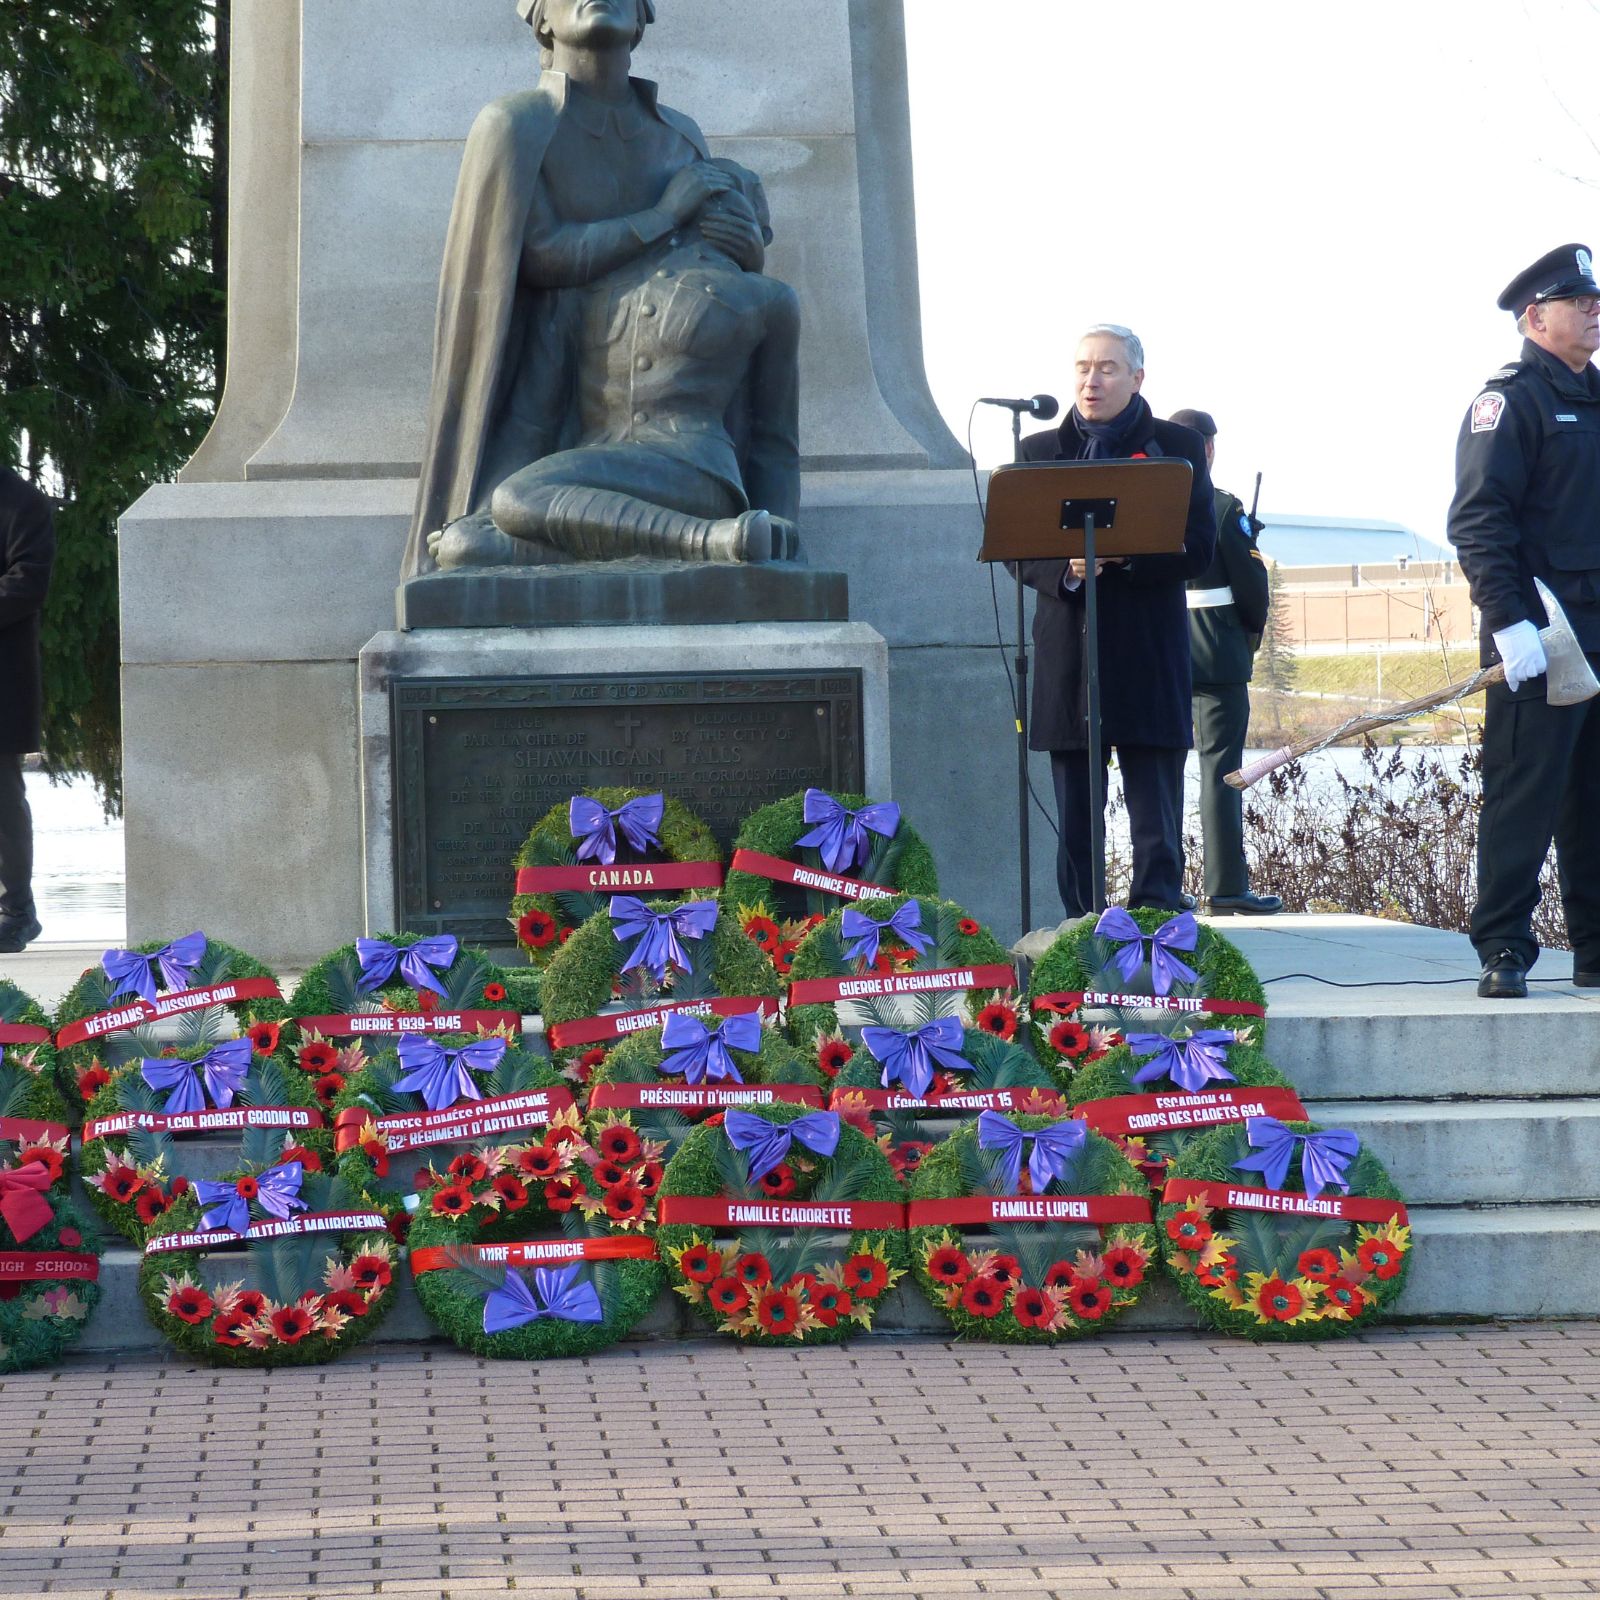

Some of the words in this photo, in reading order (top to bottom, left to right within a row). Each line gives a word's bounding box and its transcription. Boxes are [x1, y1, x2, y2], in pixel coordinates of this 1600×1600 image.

[463, 734, 496, 747] PAR
[500, 734, 520, 746] LA
[566, 732, 586, 746] DE
[671, 728, 689, 743] BY
[697, 728, 727, 742] THE
[733, 728, 768, 742] CITY
[776, 727, 793, 741] OF
[513, 748, 663, 768] SHAWINIGAN
[682, 746, 742, 766] FALLS
[485, 775, 505, 788] LA
[634, 771, 655, 785] TO
[657, 771, 689, 784] THE
[692, 768, 760, 783] GLORIOUS
[766, 766, 825, 781] MEMORY
[449, 790, 470, 803] DE
[707, 783, 778, 798] GALLANT
[463, 821, 481, 835] DE
[490, 821, 513, 835] LA
[589, 870, 654, 886] CANADA
[793, 868, 844, 893] PROVINCE
[844, 882, 859, 898] DE
[839, 979, 883, 996] GUERRE
[884, 971, 974, 992] D'AFGHANISTAN
[85, 1006, 144, 1035] VÉTÉRANS
[156, 992, 211, 1016] MISSIONS
[212, 985, 237, 1002] ONU
[1083, 992, 1092, 1004] C
[1111, 994, 1119, 1005] C
[1121, 995, 1152, 1008] 2526
[1154, 996, 1203, 1012] ST-TITE
[350, 1017, 394, 1031] GUERRE
[397, 1015, 461, 1030] 1939-1945
[616, 1011, 660, 1033] GUERRE
[640, 1087, 704, 1104] PRÉSIDENT
[707, 1089, 773, 1104] D'HONNEUR
[887, 1094, 927, 1109] LÉGION
[940, 1093, 994, 1108] DISTRICT
[997, 1091, 1012, 1107] 15
[1155, 1094, 1216, 1109] ESCADRON
[1218, 1093, 1232, 1103] 14
[376, 1117, 423, 1129] FORCES
[425, 1108, 474, 1126] ARMÉES
[475, 1092, 550, 1117] CANADIENNE
[1128, 1112, 1168, 1129] CORPS
[1169, 1109, 1192, 1125] DES
[1193, 1105, 1239, 1123] CADETS
[1240, 1102, 1266, 1118] 694
[95, 1114, 136, 1135] FILIALE
[138, 1114, 154, 1128] 44
[167, 1115, 197, 1129] LCOL
[199, 1111, 245, 1128] ROBERT
[247, 1109, 291, 1125] GRODIN
[292, 1111, 309, 1126] CD
[409, 1123, 468, 1146] RÉGIMENT
[472, 1110, 550, 1135] D'ARTILLERIE
[992, 1201, 1044, 1217] FAMILLE
[1046, 1201, 1089, 1217] LUPIEN
[1228, 1190, 1280, 1210] FAMILLE
[1281, 1197, 1342, 1216] FLAGEOLE
[728, 1205, 780, 1222] FAMILLE
[782, 1207, 852, 1225] CADORETTE
[181, 1233, 237, 1246] HISTOIRE
[304, 1214, 388, 1232] MAURICIENNE
[523, 1243, 584, 1259] MAURICIE
[35, 1261, 91, 1272] SCHOOL
